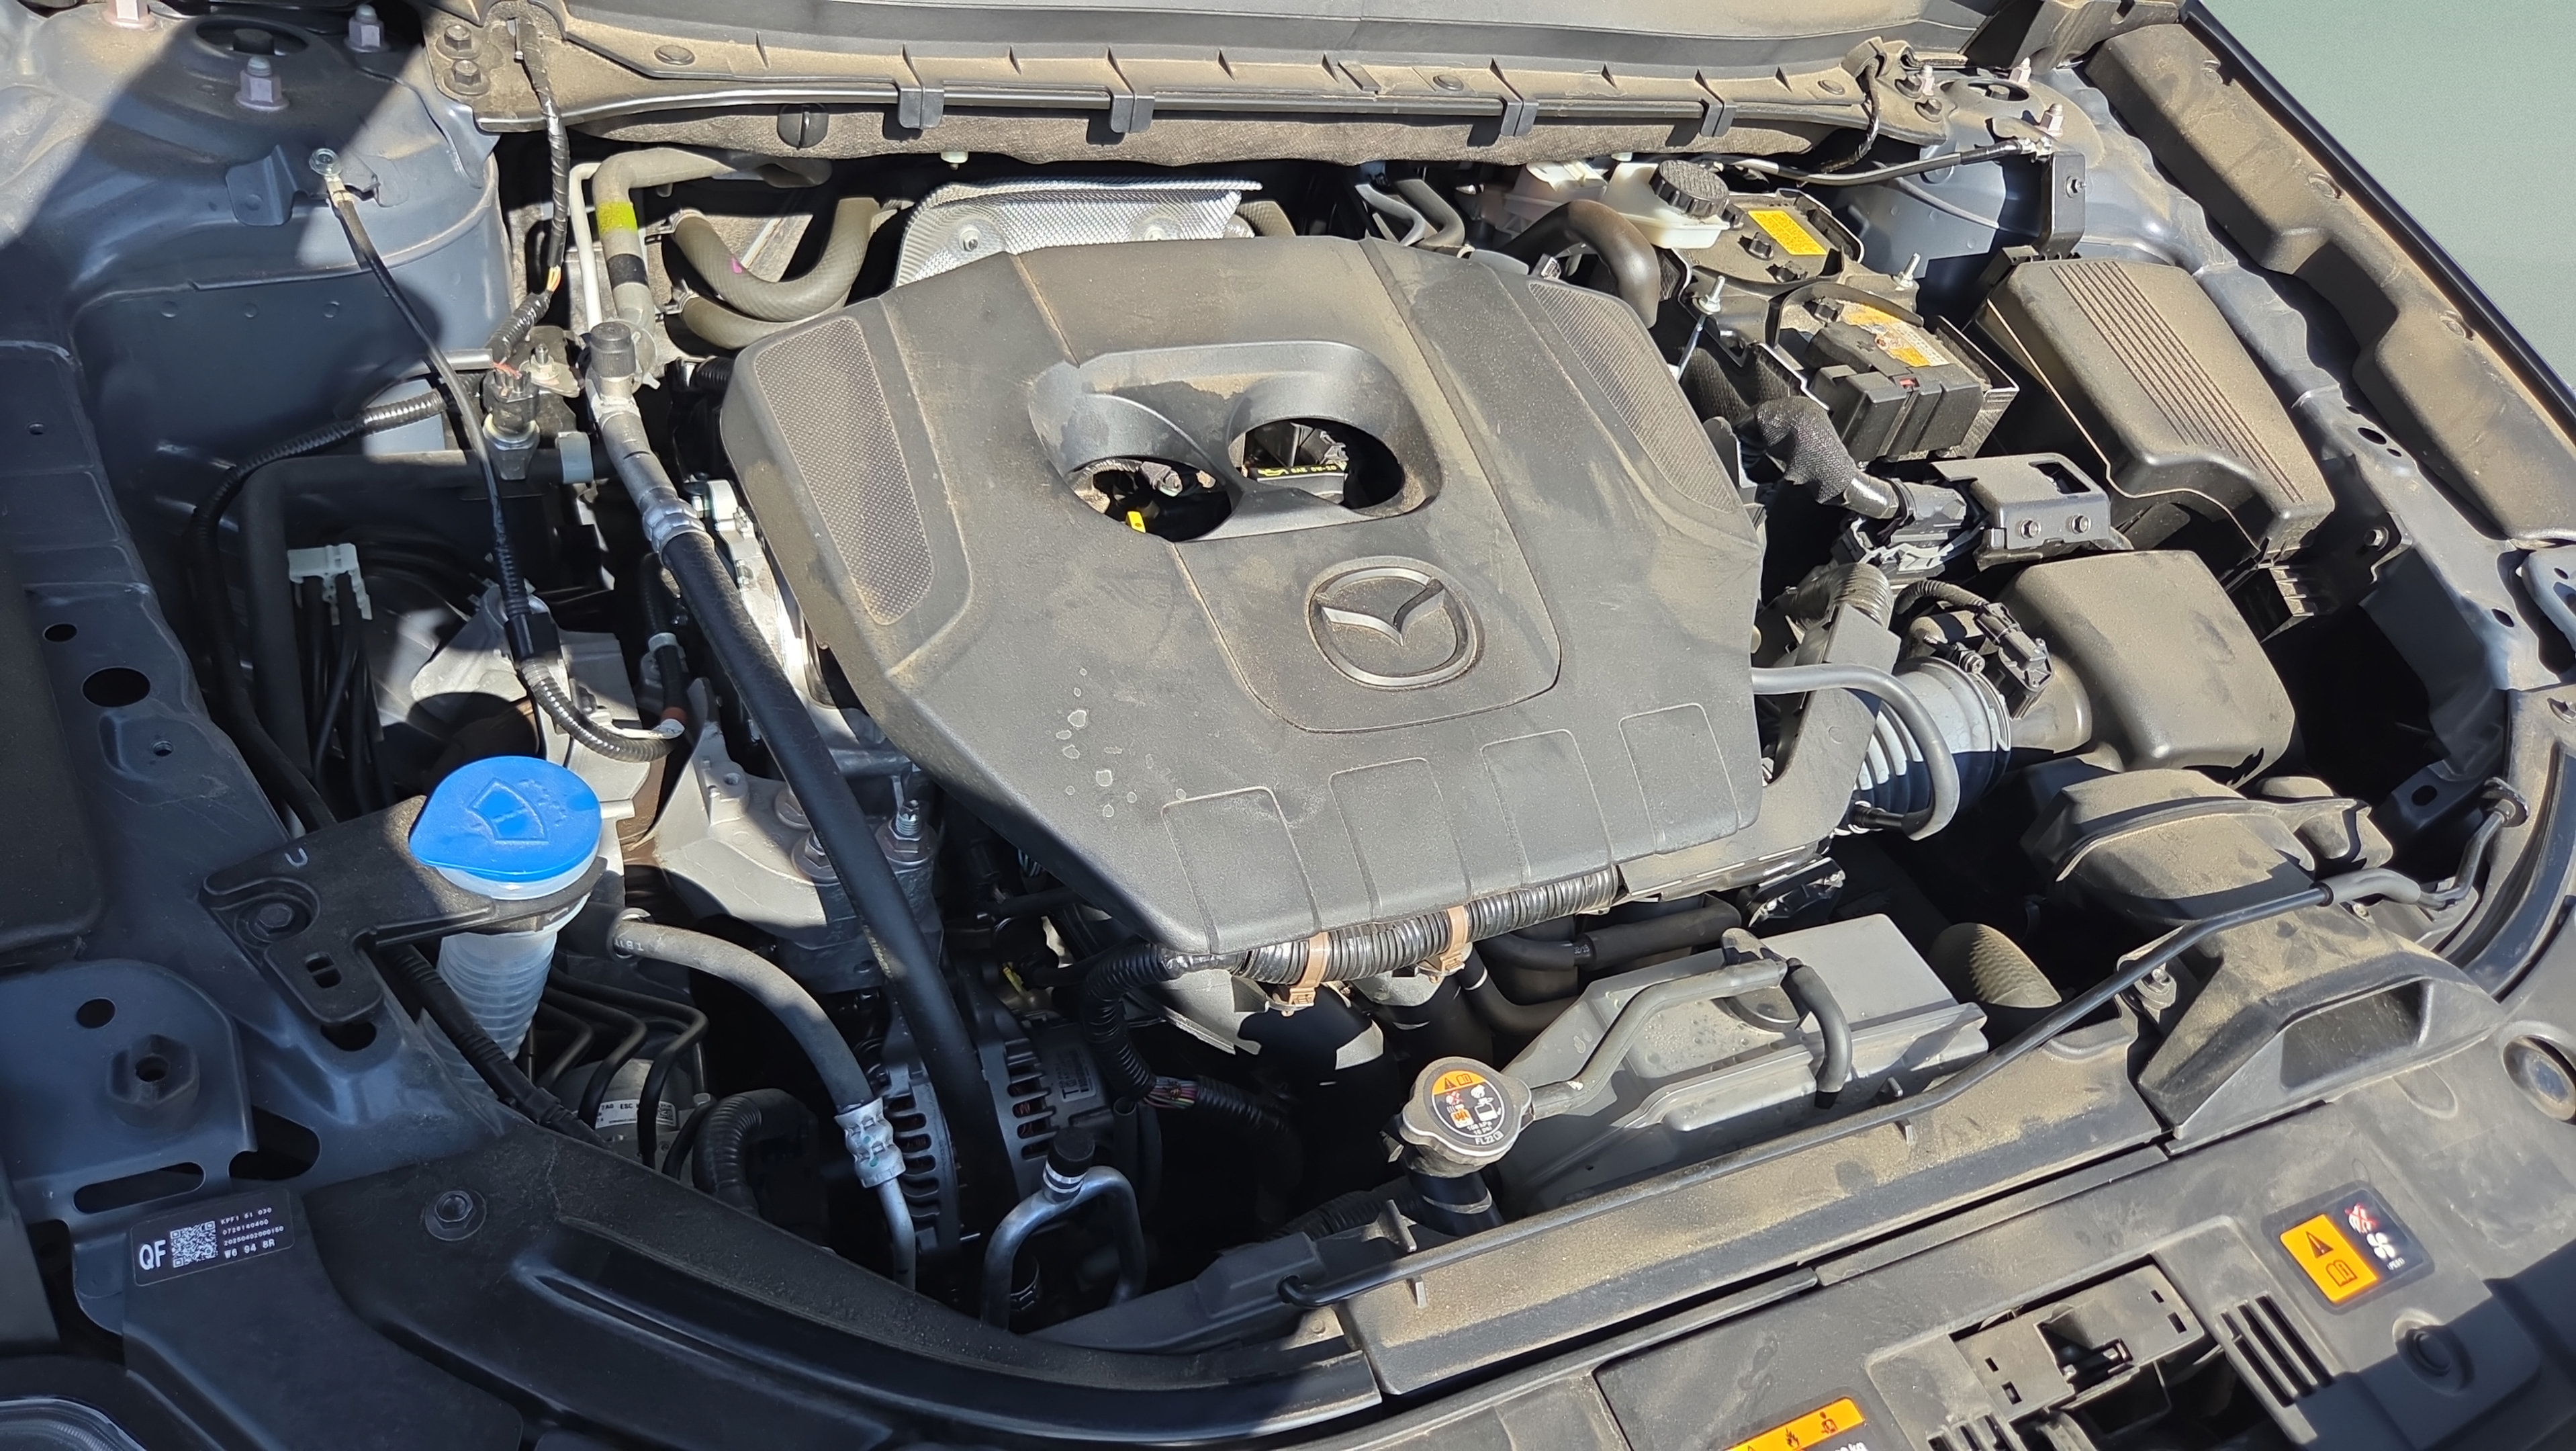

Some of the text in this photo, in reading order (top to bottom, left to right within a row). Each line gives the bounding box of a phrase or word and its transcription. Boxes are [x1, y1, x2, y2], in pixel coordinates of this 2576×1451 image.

[1475, 1136, 1496, 1145] FL22
[244, 1243, 257, 1254] 94
[139, 1239, 167, 1270] QF
